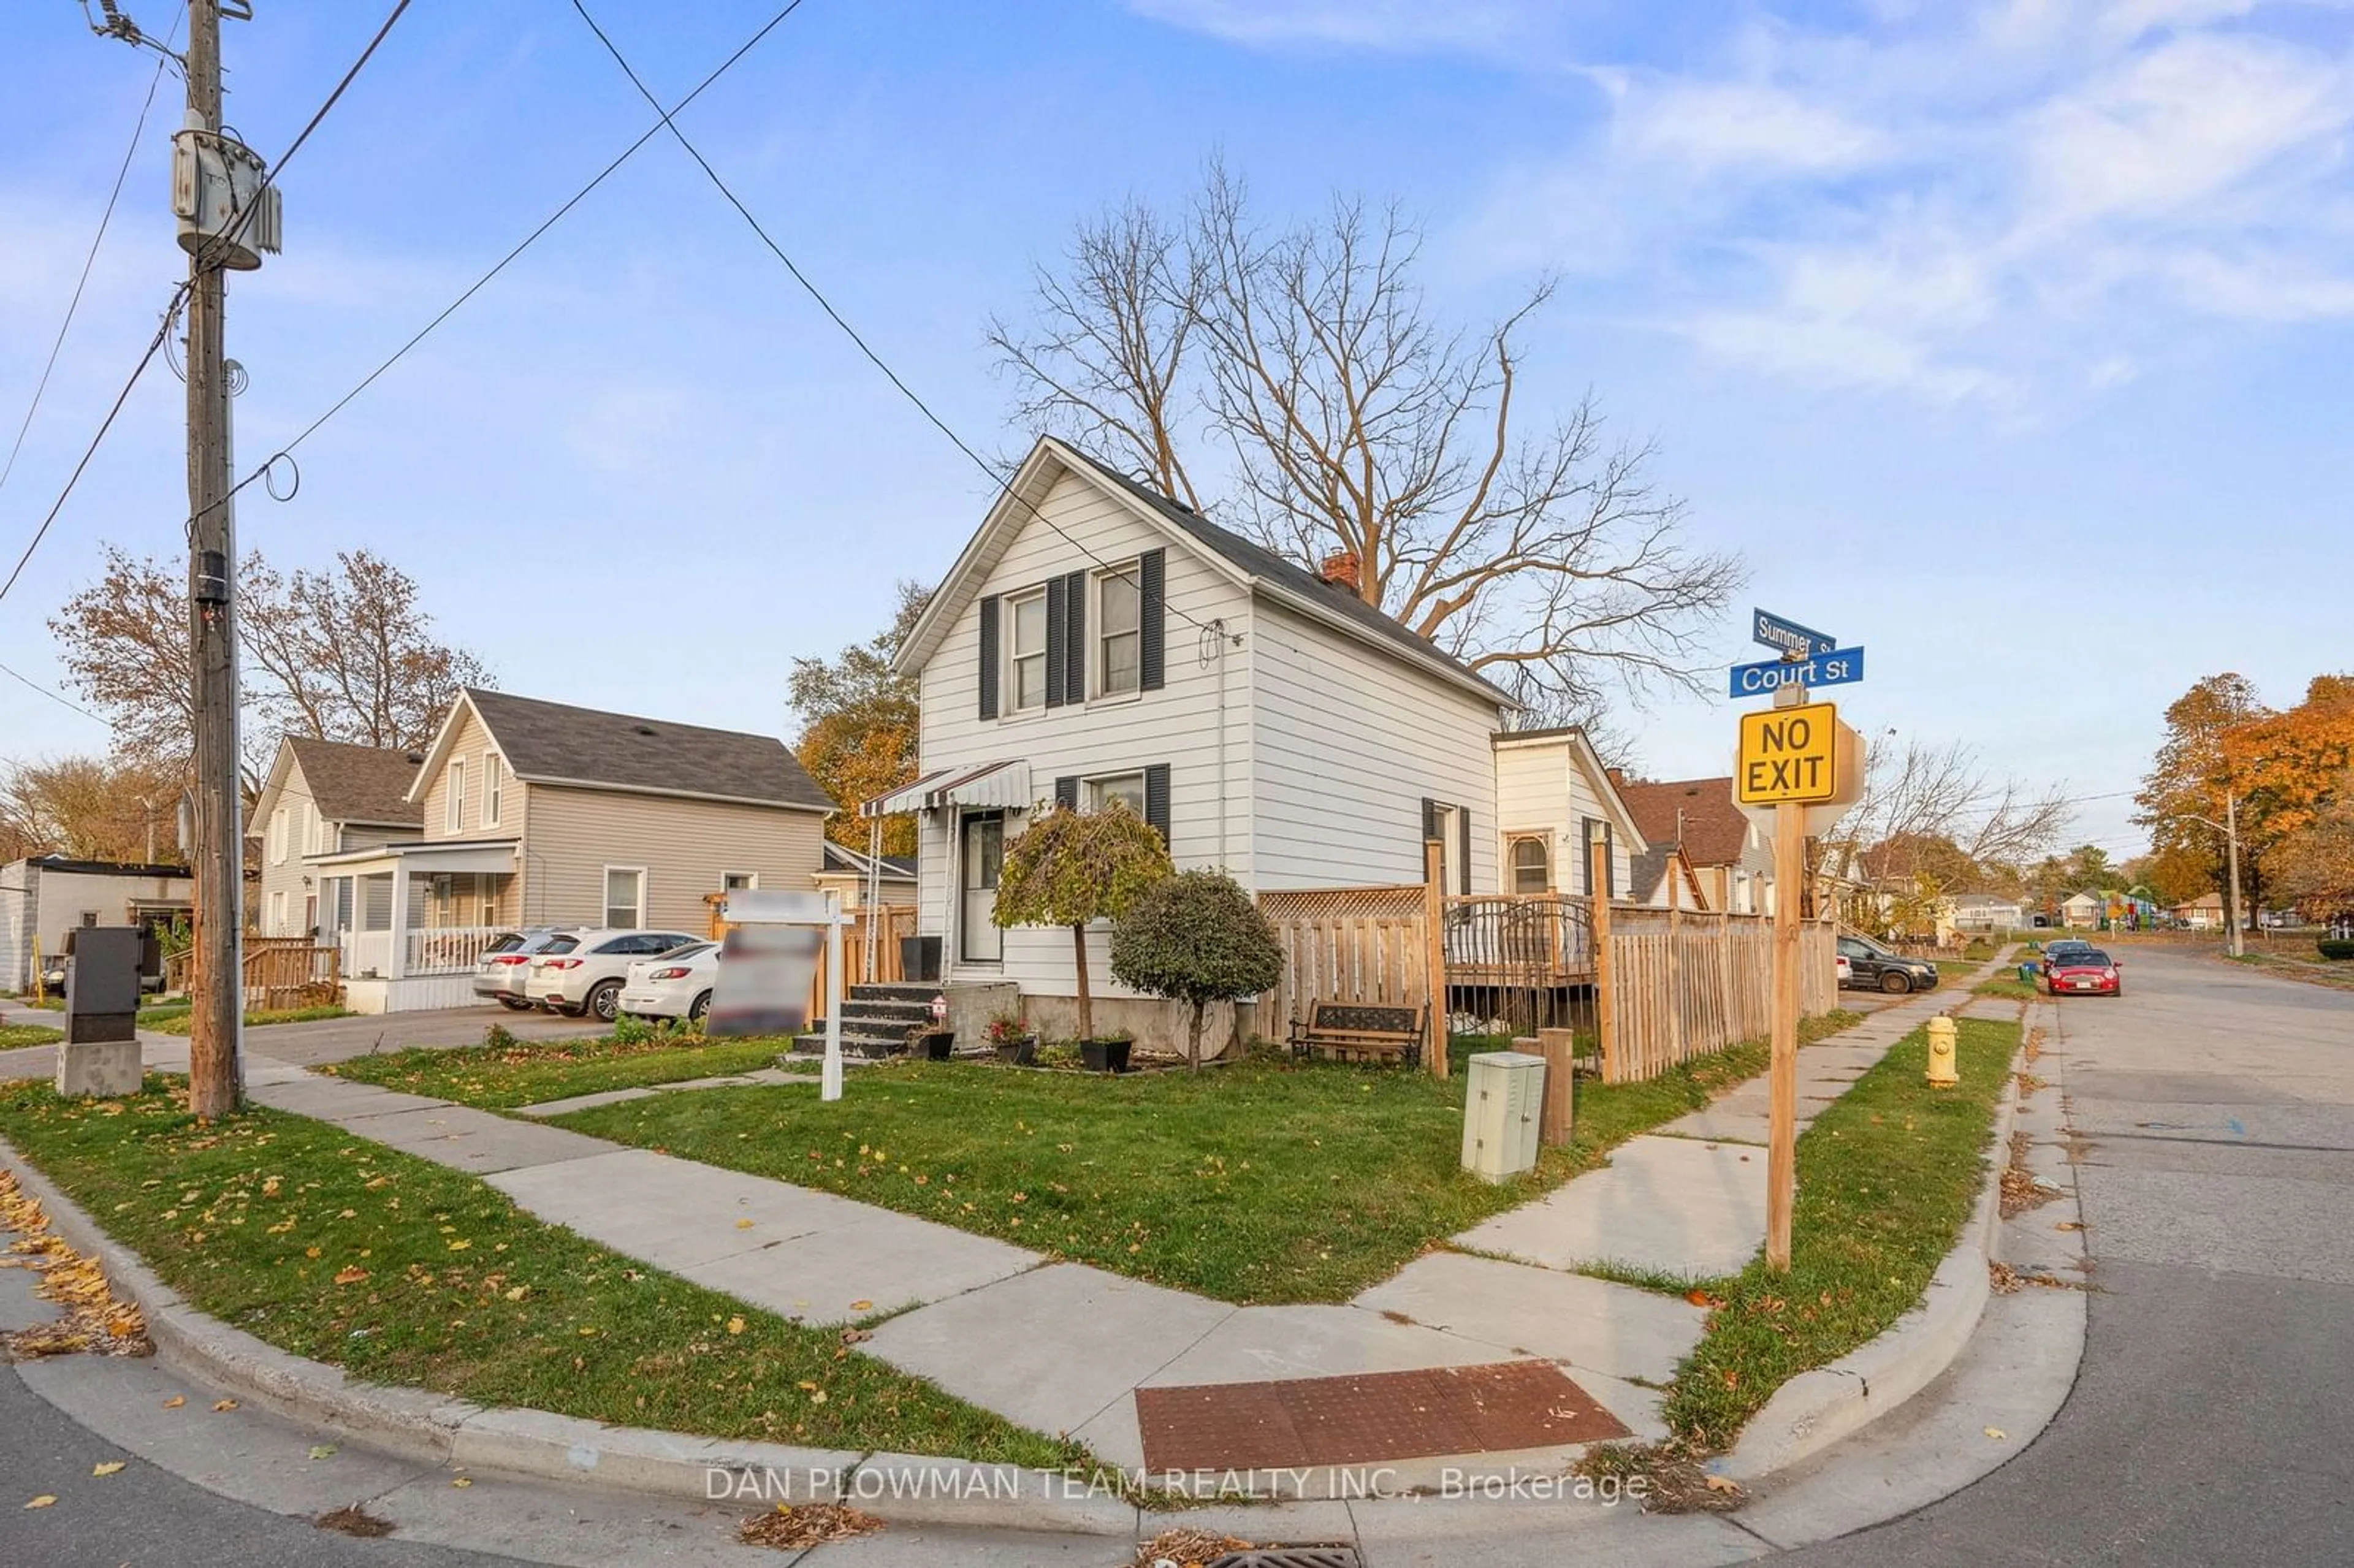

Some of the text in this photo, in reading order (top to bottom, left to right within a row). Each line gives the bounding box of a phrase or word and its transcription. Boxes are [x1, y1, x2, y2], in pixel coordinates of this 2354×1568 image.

[1758, 615, 1811, 653] Summer
[1742, 660, 1848, 690] Court St
[1762, 718, 1810, 754] NO
[1748, 755, 1824, 792] EXIT
